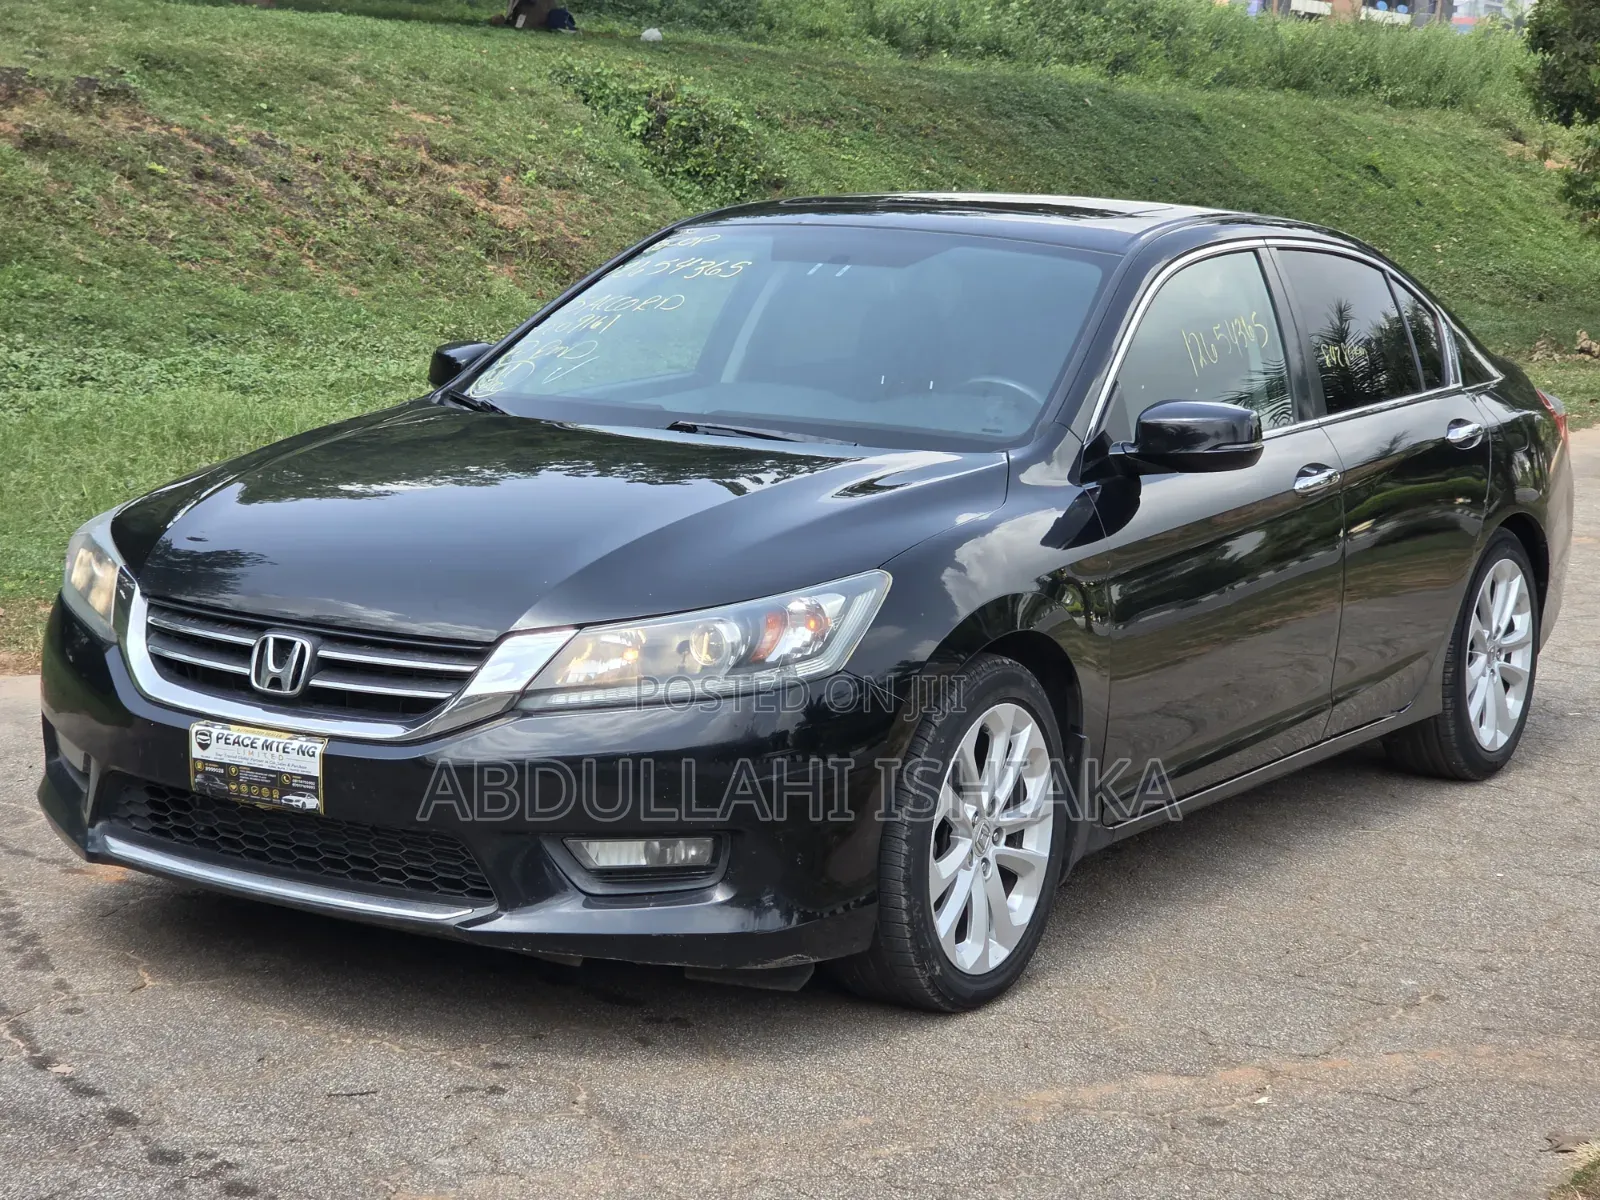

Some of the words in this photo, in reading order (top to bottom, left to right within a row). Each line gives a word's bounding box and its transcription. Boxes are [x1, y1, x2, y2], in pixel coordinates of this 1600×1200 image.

[215, 732, 260, 749] PEACE
[261, 739, 318, 758] MTE-NG
[236, 749, 284, 761] LIMITED
